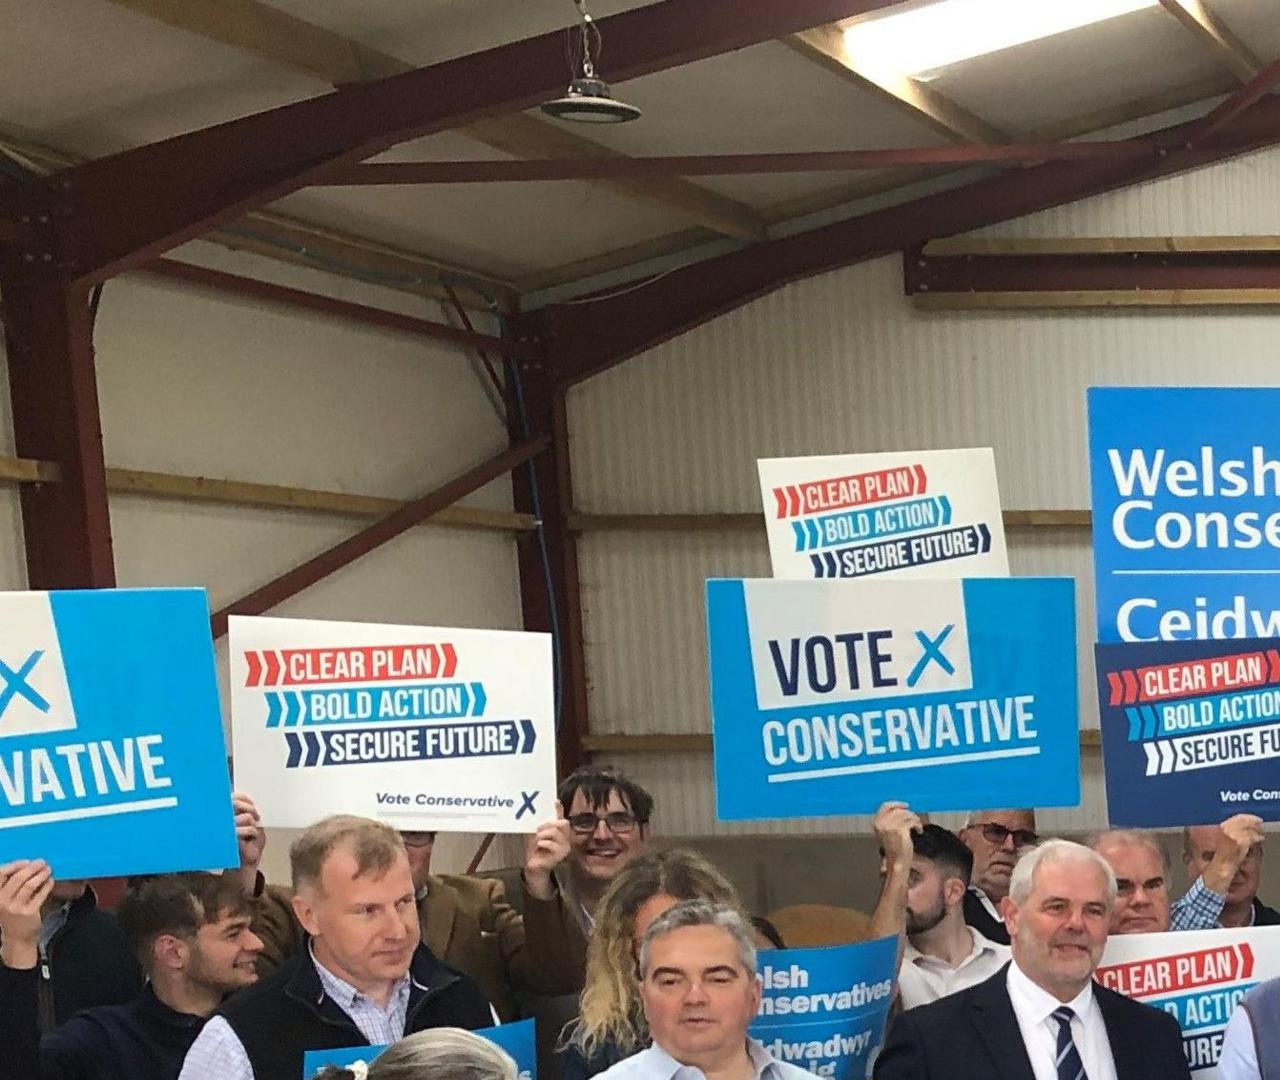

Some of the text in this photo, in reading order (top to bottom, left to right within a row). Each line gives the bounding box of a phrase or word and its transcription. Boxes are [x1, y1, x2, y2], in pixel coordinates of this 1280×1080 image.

[806, 470, 909, 509] CLEAR PLAN
[826, 501, 934, 543] BOLD ACTION
[843, 528, 975, 576] SECURE FUTURE
[290, 649, 432, 681] CLEAR PLAN
[768, 630, 898, 696] VOTE
[1144, 657, 1262, 697] CLEAR PLAN
[311, 687, 462, 721] BOLD ACTION
[1163, 701, 1213, 732] BOLD
[329, 724, 513, 762] SECURE FUTURE
[761, 695, 1038, 766] CONSERVATIVE
[1182, 733, 1252, 766] SECURE
[0, 735, 173, 806] VATIVE
[376, 792, 410, 806] Vote
[415, 793, 514, 808] Conservative
[1220, 790, 1250, 802] Vote
[757, 965, 808, 989] lsh
[1104, 951, 1232, 996] CLEAR PLAN
[757, 979, 891, 1016] nservatives
[1185, 988, 1248, 1025] ACTI
